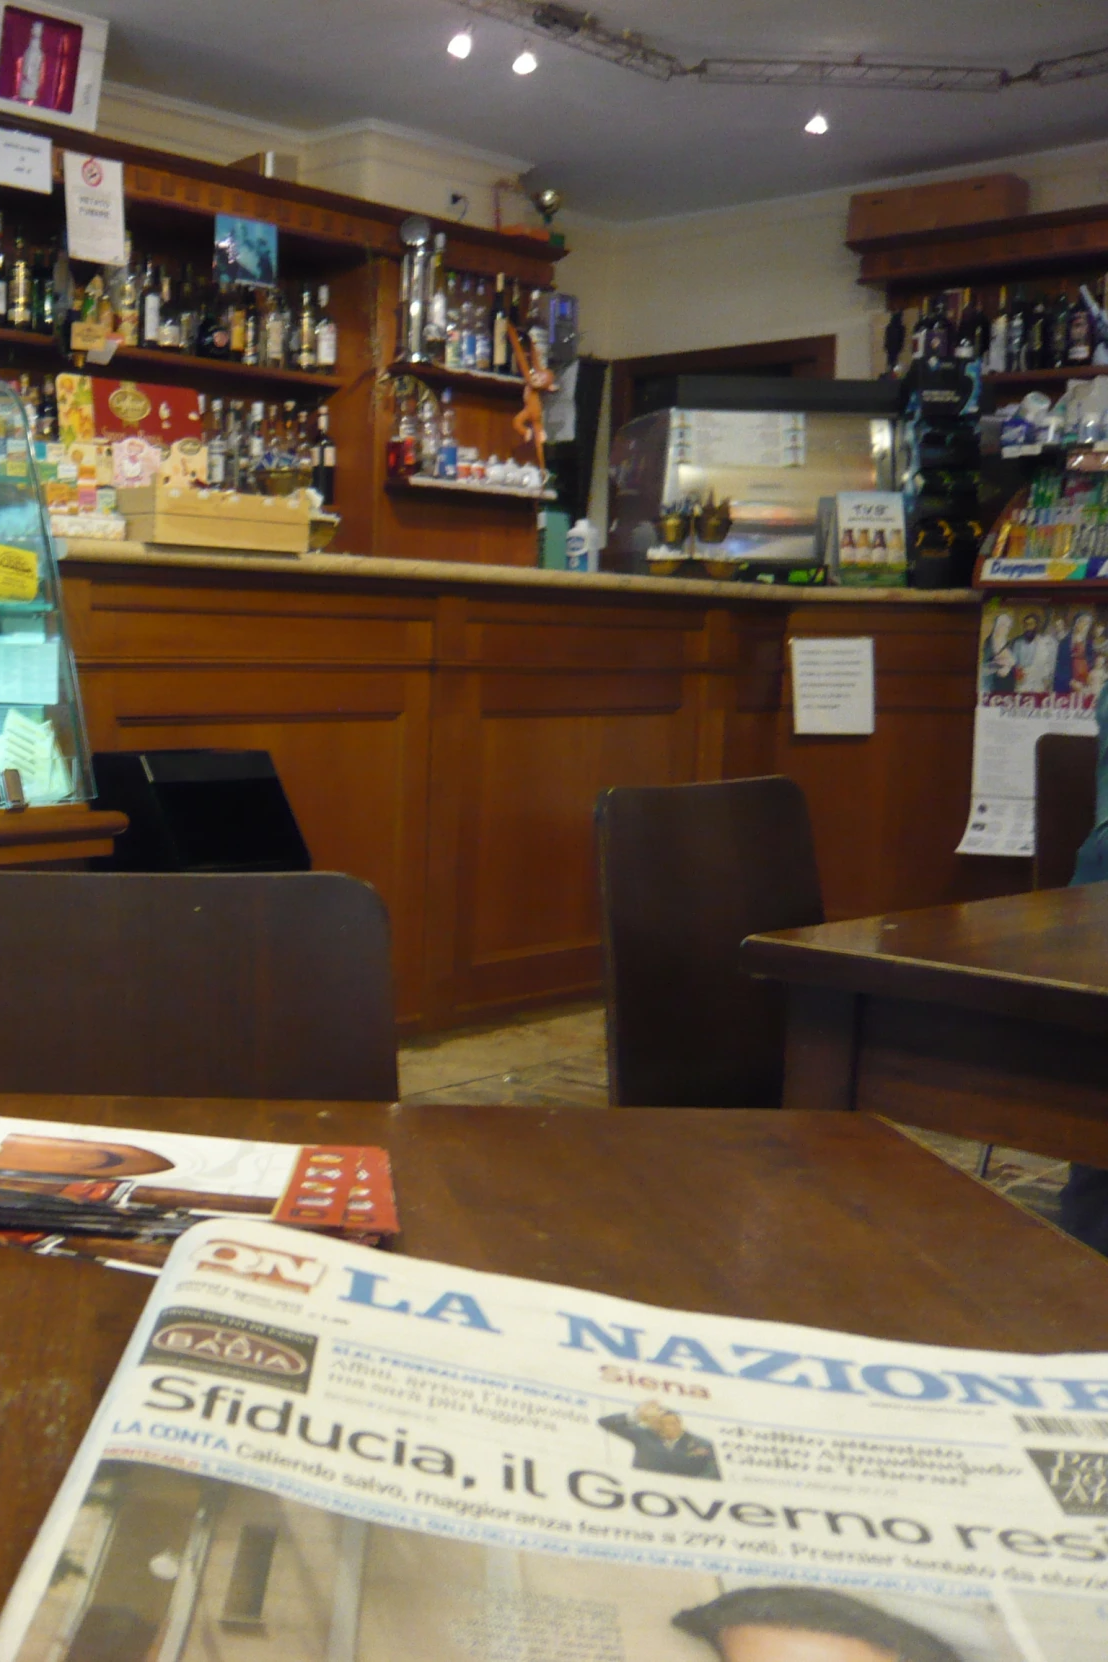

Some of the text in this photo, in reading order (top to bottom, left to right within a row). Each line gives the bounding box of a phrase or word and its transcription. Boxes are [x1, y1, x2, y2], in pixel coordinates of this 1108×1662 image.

[338, 1266, 504, 1335] LA
[555, 1311, 1108, 1411] NAZIONE
[598, 1363, 712, 1400] Siena
[111, 1420, 141, 1437] LA
[150, 1422, 230, 1451] CONTA
[235, 1441, 336, 1482] Caliendo
[341, 1472, 409, 1502] salvo,
[415, 1489, 572, 1533] maggioranza
[578, 1519, 655, 1545] ferma
[661, 1532, 678, 1545] a
[682, 1529, 726, 1549] 299
[791, 1541, 896, 1567] Premier
[144, 1374, 477, 1490] Sfiducia,
[502, 1453, 548, 1500] il
[566, 1469, 933, 1546] Governo
